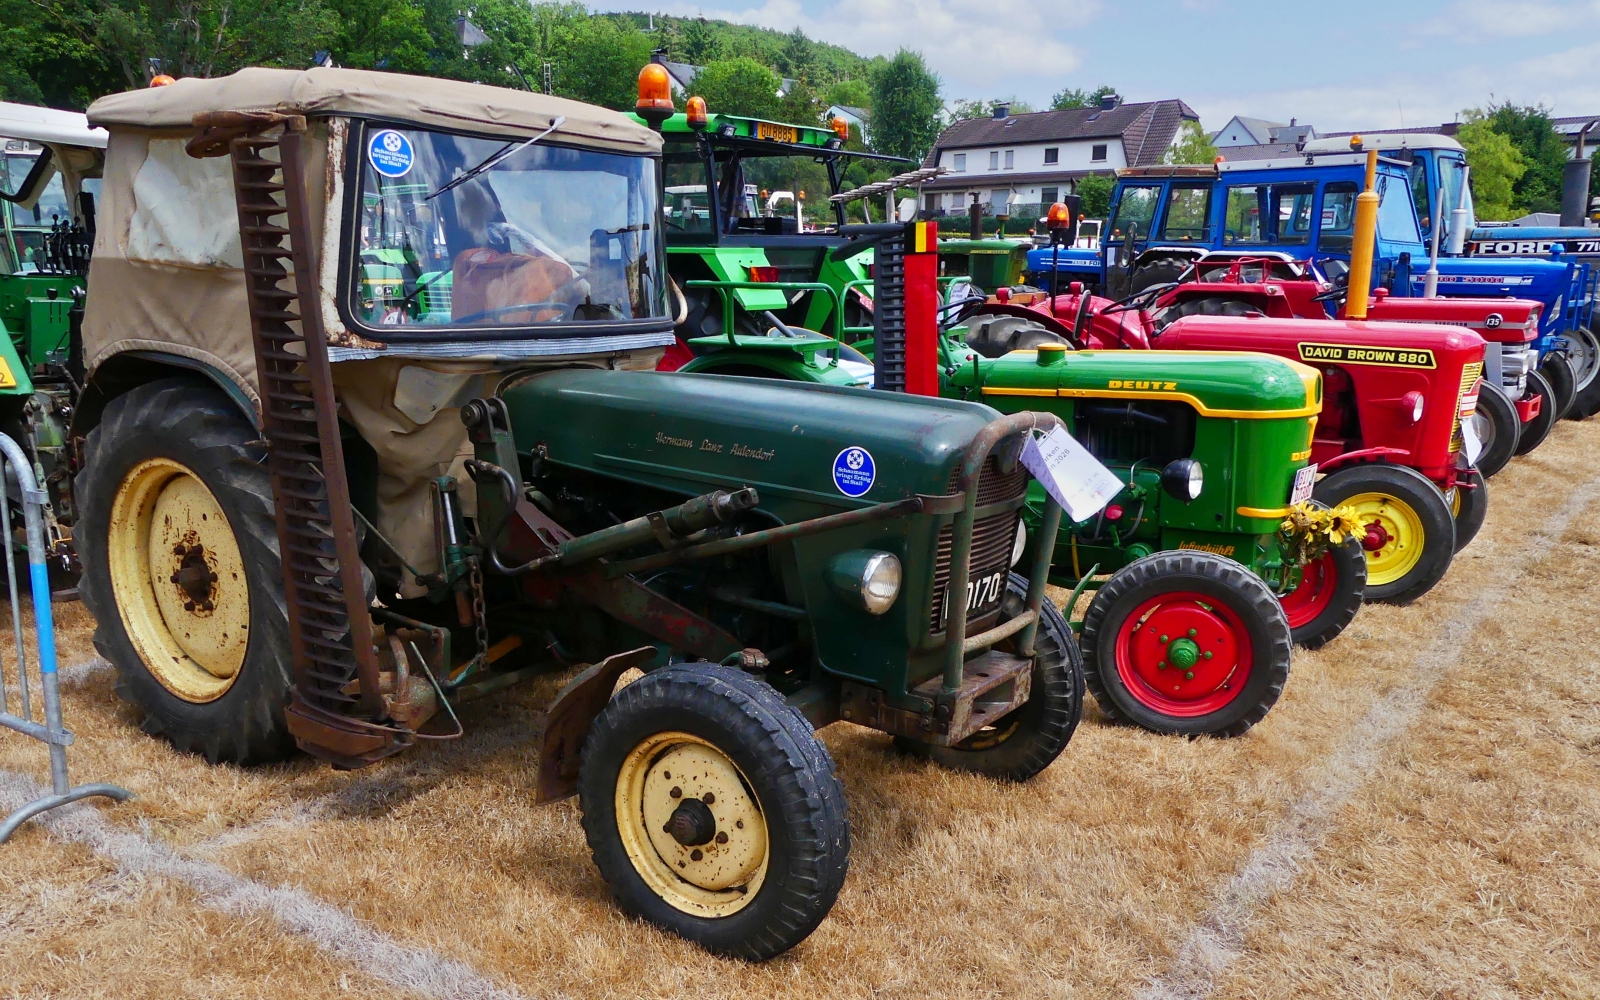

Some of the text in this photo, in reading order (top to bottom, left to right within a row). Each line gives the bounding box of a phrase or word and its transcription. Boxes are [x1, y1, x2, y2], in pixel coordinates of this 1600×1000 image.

[1479, 241, 1600, 254] FORD 771
[1486, 318, 1499, 326] 135
[1305, 347, 1428, 364] DAVID BROWN 880
[1108, 380, 1177, 391] DEUTZ
[655, 431, 775, 461] Hermann Lanz Aulendorf
[836, 472, 871, 483] bringt Erfolg
[837, 467, 870, 477] Schaumann
